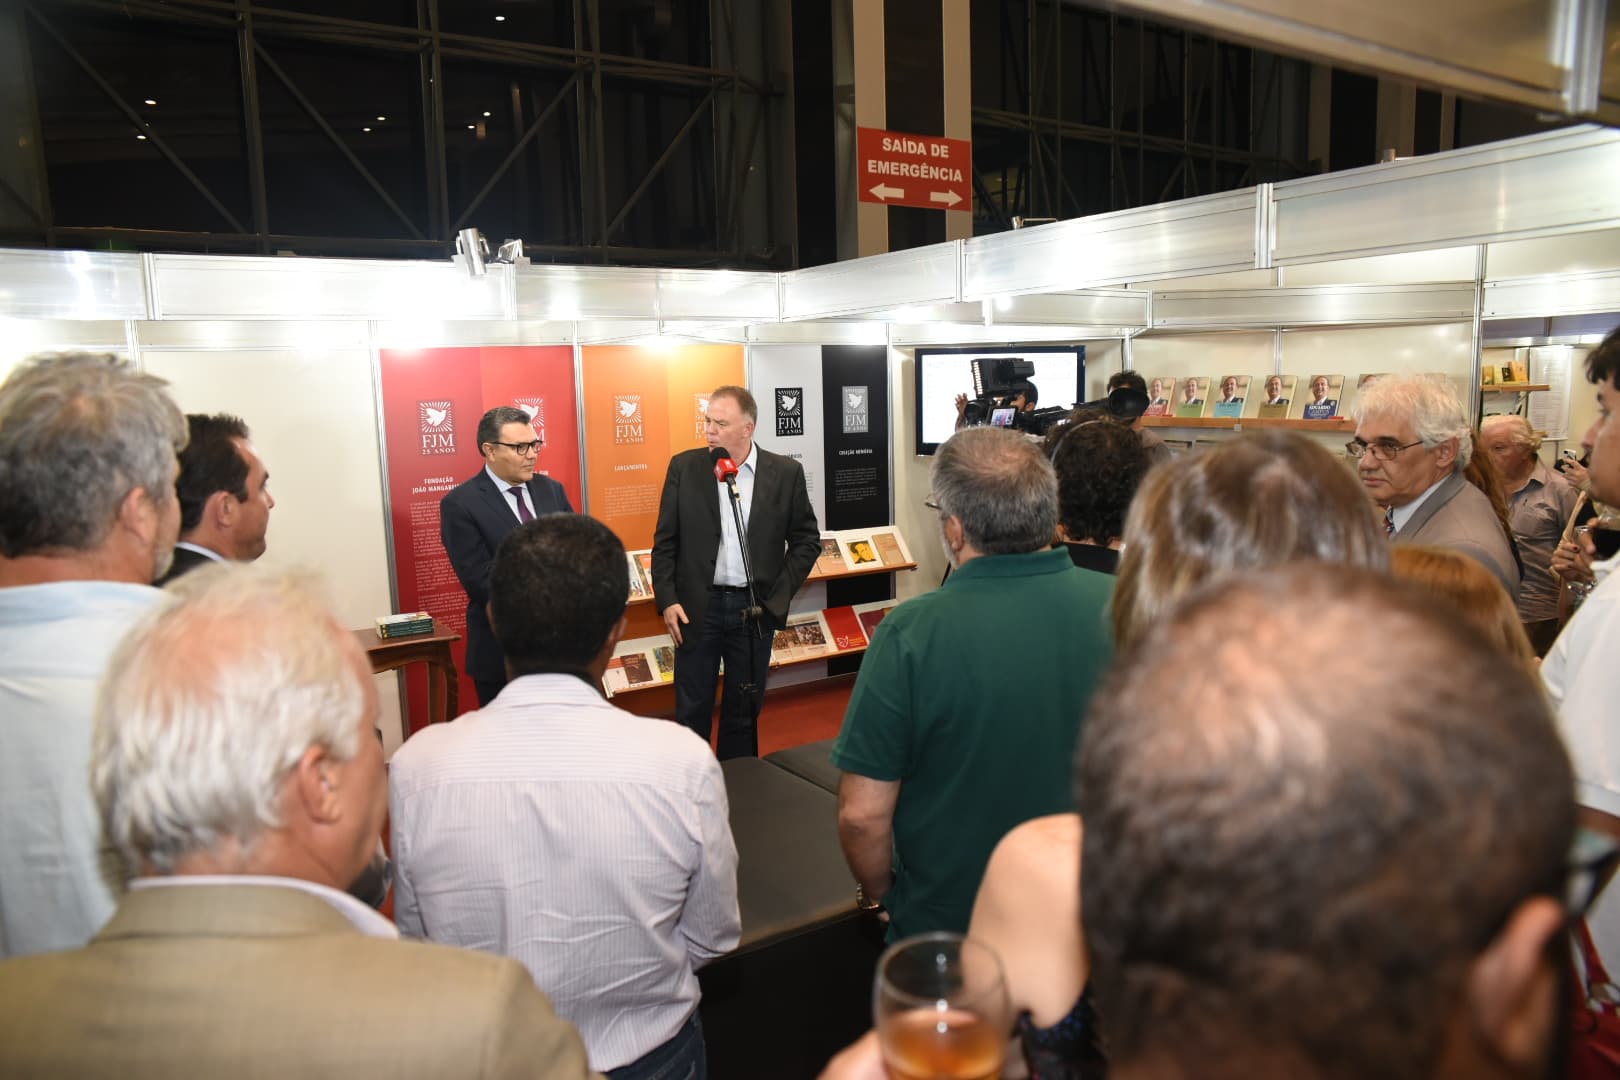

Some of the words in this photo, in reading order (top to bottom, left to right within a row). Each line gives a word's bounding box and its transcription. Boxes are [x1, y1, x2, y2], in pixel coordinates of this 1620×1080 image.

[882, 137, 927, 156] SAÍDA
[930, 143, 949, 158] DE
[867, 159, 963, 182] EMERGÊNCIA
[778, 416, 801, 430] FJM
[845, 414, 867, 427] FJM
[616, 424, 642, 438] FJM
[422, 433, 456, 448] FJM
[412, 486, 427, 495] JOÃO
